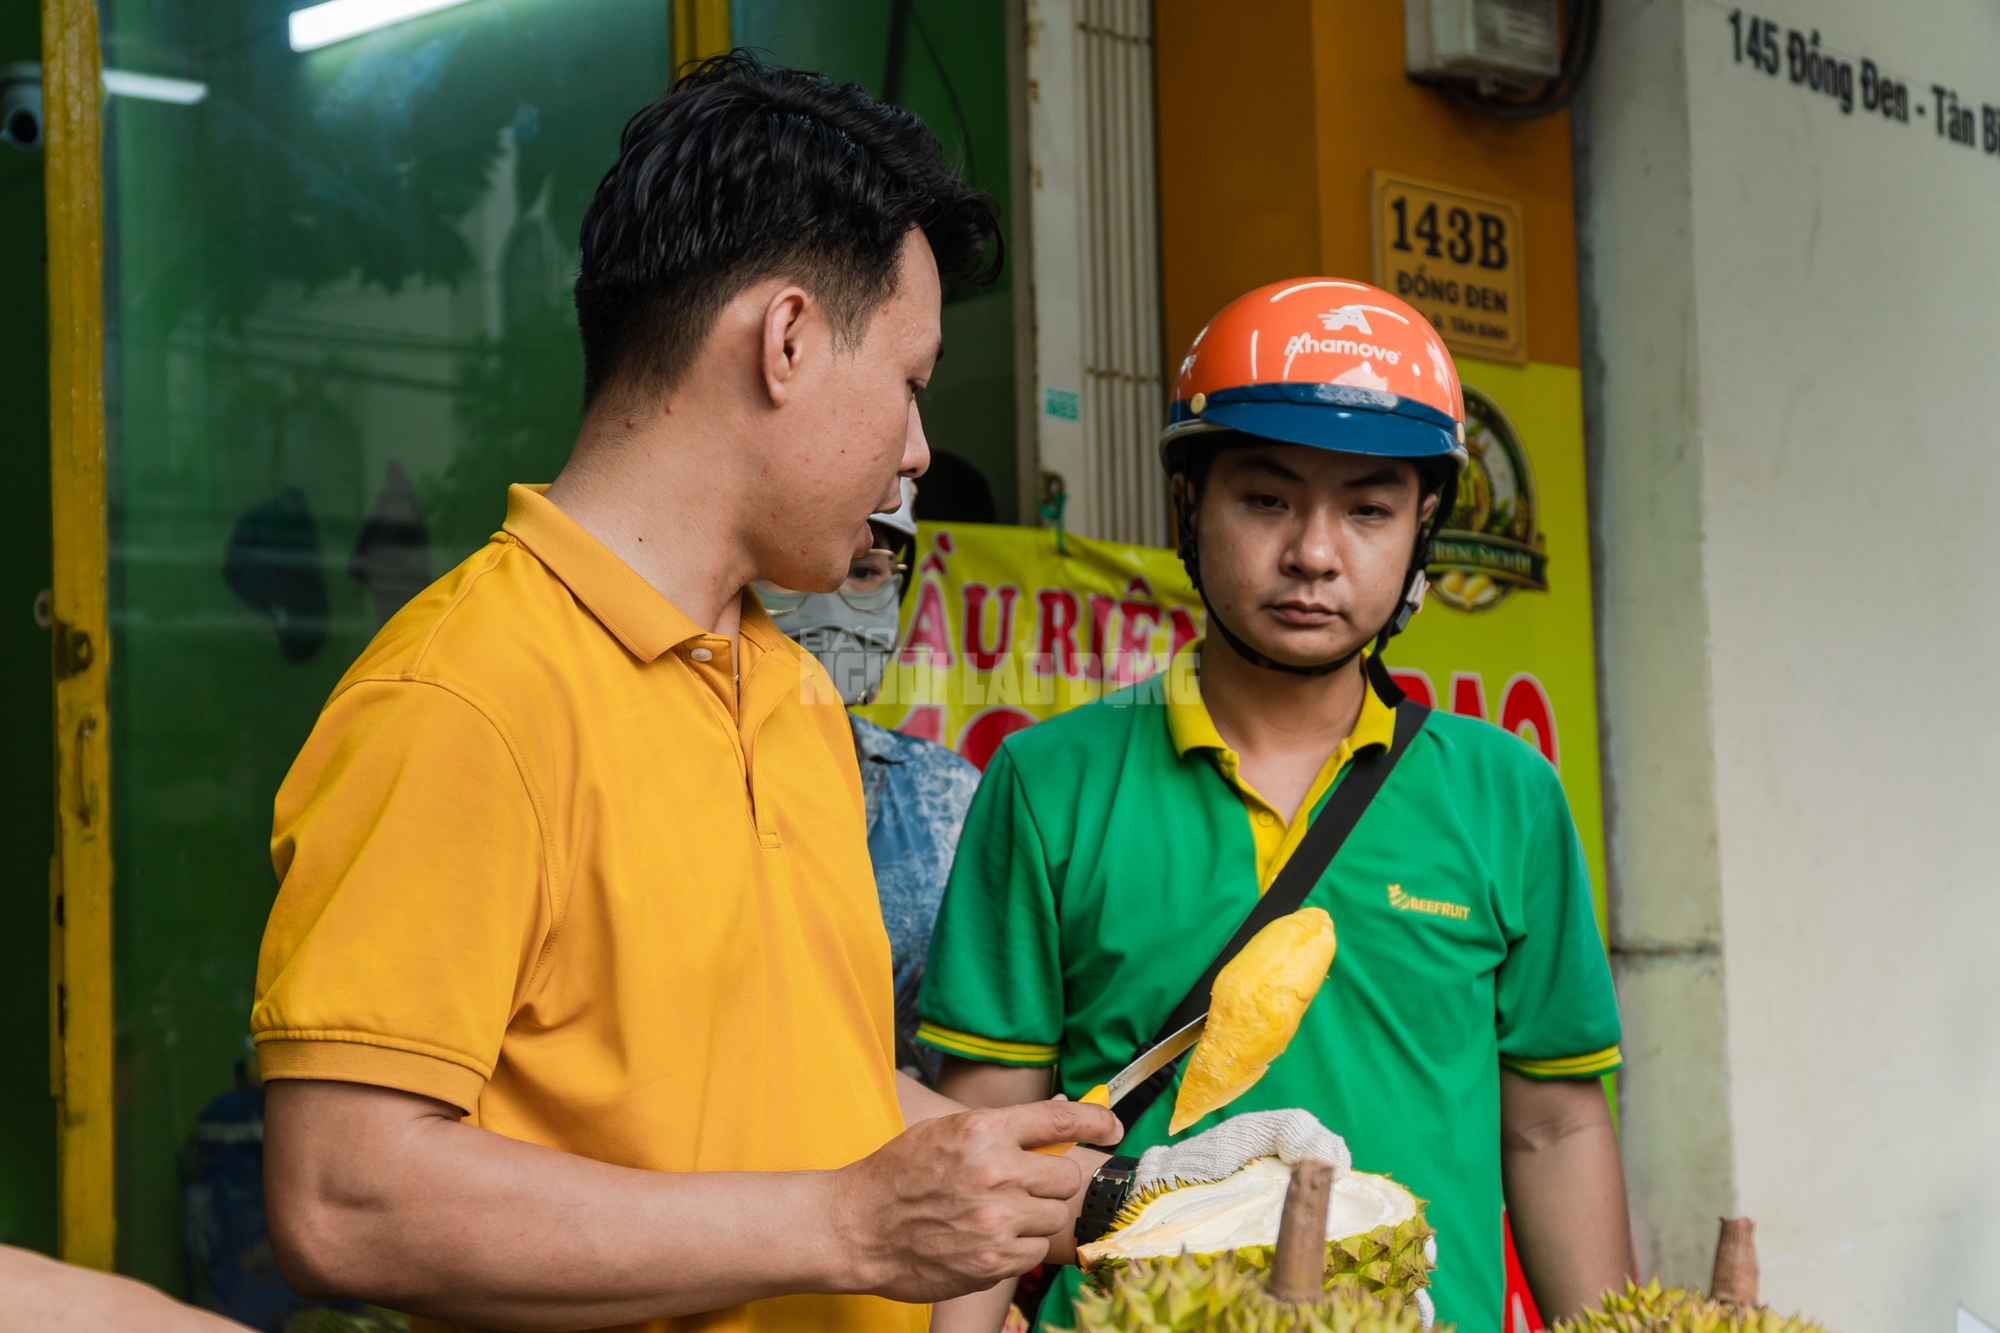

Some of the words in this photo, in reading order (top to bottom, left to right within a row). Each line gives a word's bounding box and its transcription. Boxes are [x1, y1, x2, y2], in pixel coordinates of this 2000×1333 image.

[1728, 7, 1779, 76] 145
[1860, 57, 1908, 124] Đen
[1931, 84, 1975, 147] Tân
[1391, 195, 1508, 271] 143B
[1464, 283, 1507, 314] ĐEN
[898, 530, 1020, 673] ẦU
[1410, 896, 1470, 920] BEEFRUIT
